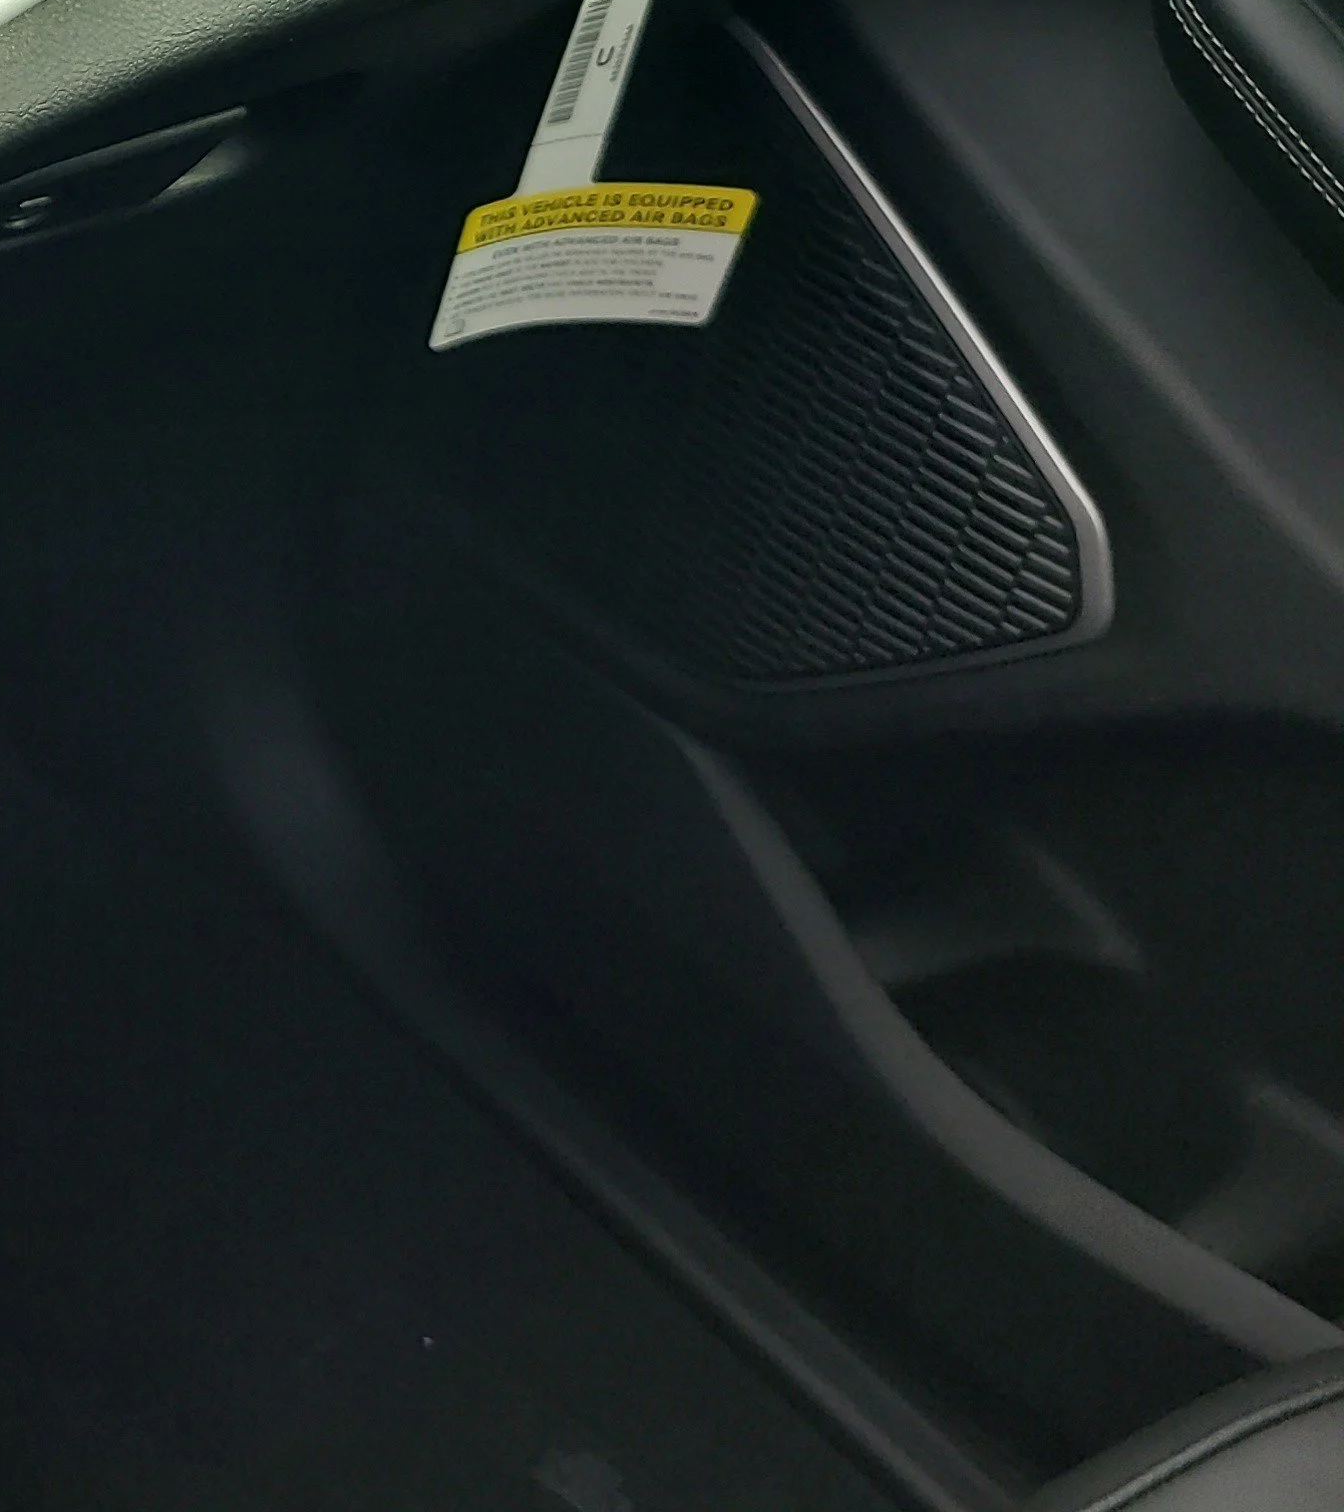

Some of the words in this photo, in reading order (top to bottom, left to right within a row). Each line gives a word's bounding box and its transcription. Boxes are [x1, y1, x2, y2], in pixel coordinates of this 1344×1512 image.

[520, 194, 599, 216] VEHICLE
[602, 193, 622, 206] IS
[628, 193, 735, 212] EQUIPPED
[521, 210, 626, 230] ADVANCED
[629, 210, 666, 225] AIR
[670, 211, 728, 228] BAGS
